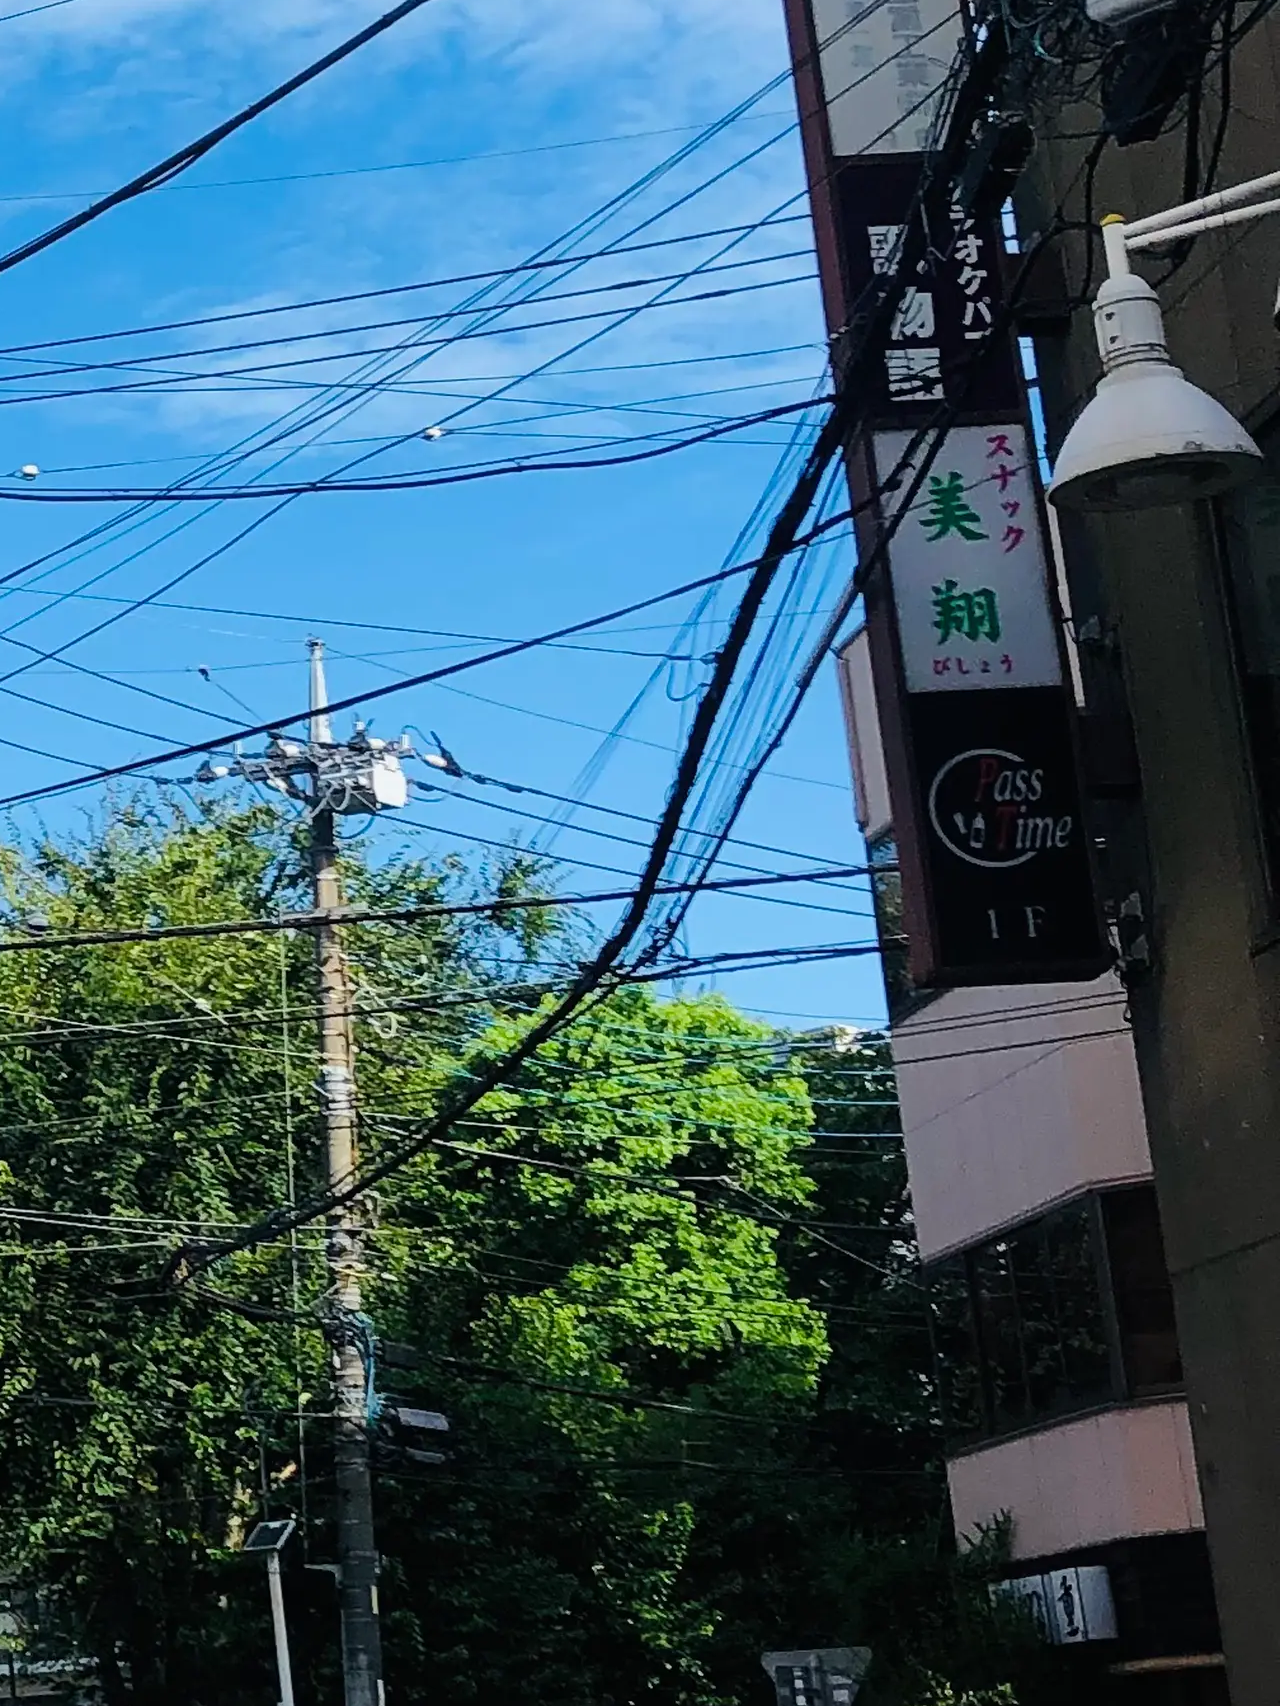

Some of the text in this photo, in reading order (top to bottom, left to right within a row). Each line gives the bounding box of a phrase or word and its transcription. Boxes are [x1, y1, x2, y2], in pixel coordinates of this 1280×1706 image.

[986, 434, 1025, 554] スナック
[918, 471, 1001, 645] 美翔
[933, 654, 1012, 674] びしょう
[973, 757, 1044, 803] Pass
[995, 803, 1072, 852] Time
